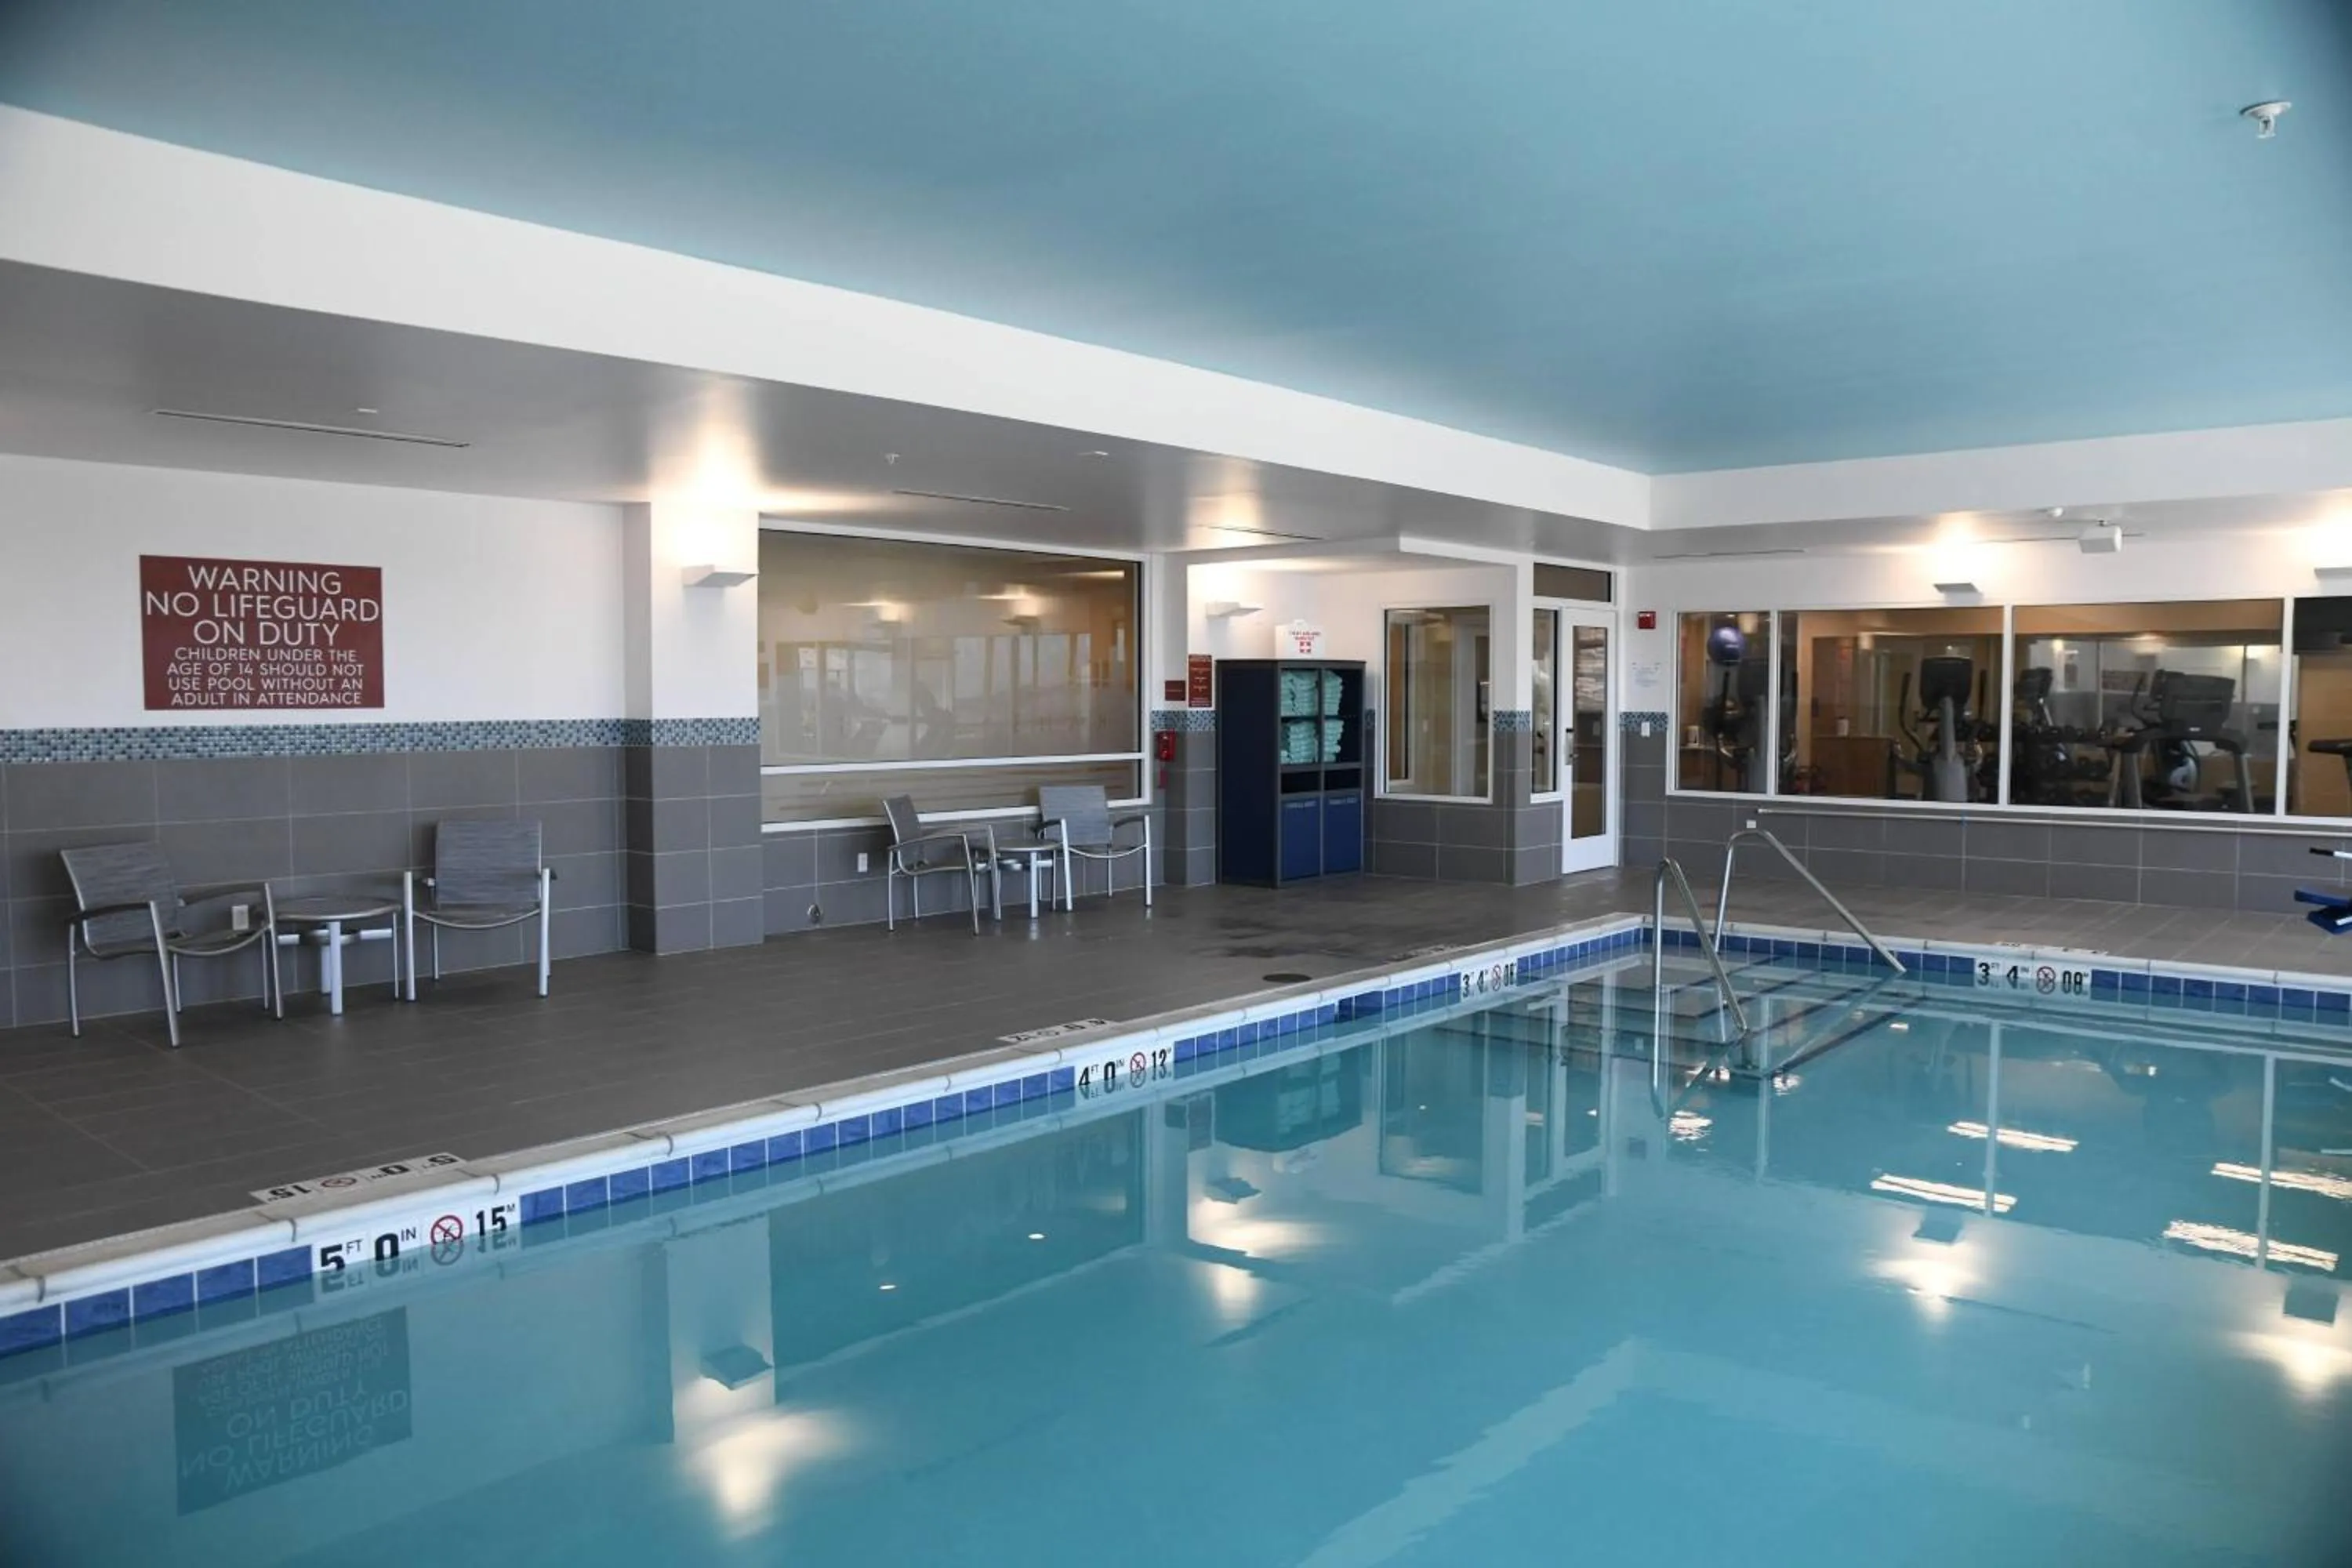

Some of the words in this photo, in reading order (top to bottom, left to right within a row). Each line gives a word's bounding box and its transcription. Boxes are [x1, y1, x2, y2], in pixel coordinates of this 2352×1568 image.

[187, 564, 341, 595] WARNING
[146, 591, 200, 617] NO
[213, 593, 380, 622] LIFEGUARD
[193, 619, 245, 644] ON
[260, 622, 339, 646] DUTY
[175, 647, 260, 662] CHILDREN
[267, 648, 323, 662] UNDER
[328, 649, 357, 662] THE
[166, 662, 201, 676] AGE
[208, 662, 232, 676] OF
[238, 663, 253, 676] 14
[260, 663, 327, 677] SHOULD
[332, 663, 365, 677] NOT
[169, 677, 201, 691] USE
[208, 677, 256, 691] POOL
[260, 677, 336, 691] WITHOUT
[341, 677, 364, 691] AN
[170, 692, 227, 706] ADULT
[233, 692, 251, 706] IN
[256, 692, 362, 706] ATTENDANCE
[1978, 962, 1990, 976] 3
[2006, 965, 2018, 979] 4
[1079, 1066, 1091, 1086] 4
[1104, 1062, 1116, 1080] 0
[320, 1243, 345, 1271] 5
[346, 1239, 363, 1254] FT
[375, 1232, 399, 1261] 0
[401, 1227, 416, 1242] IN
[476, 1206, 507, 1236] 15
